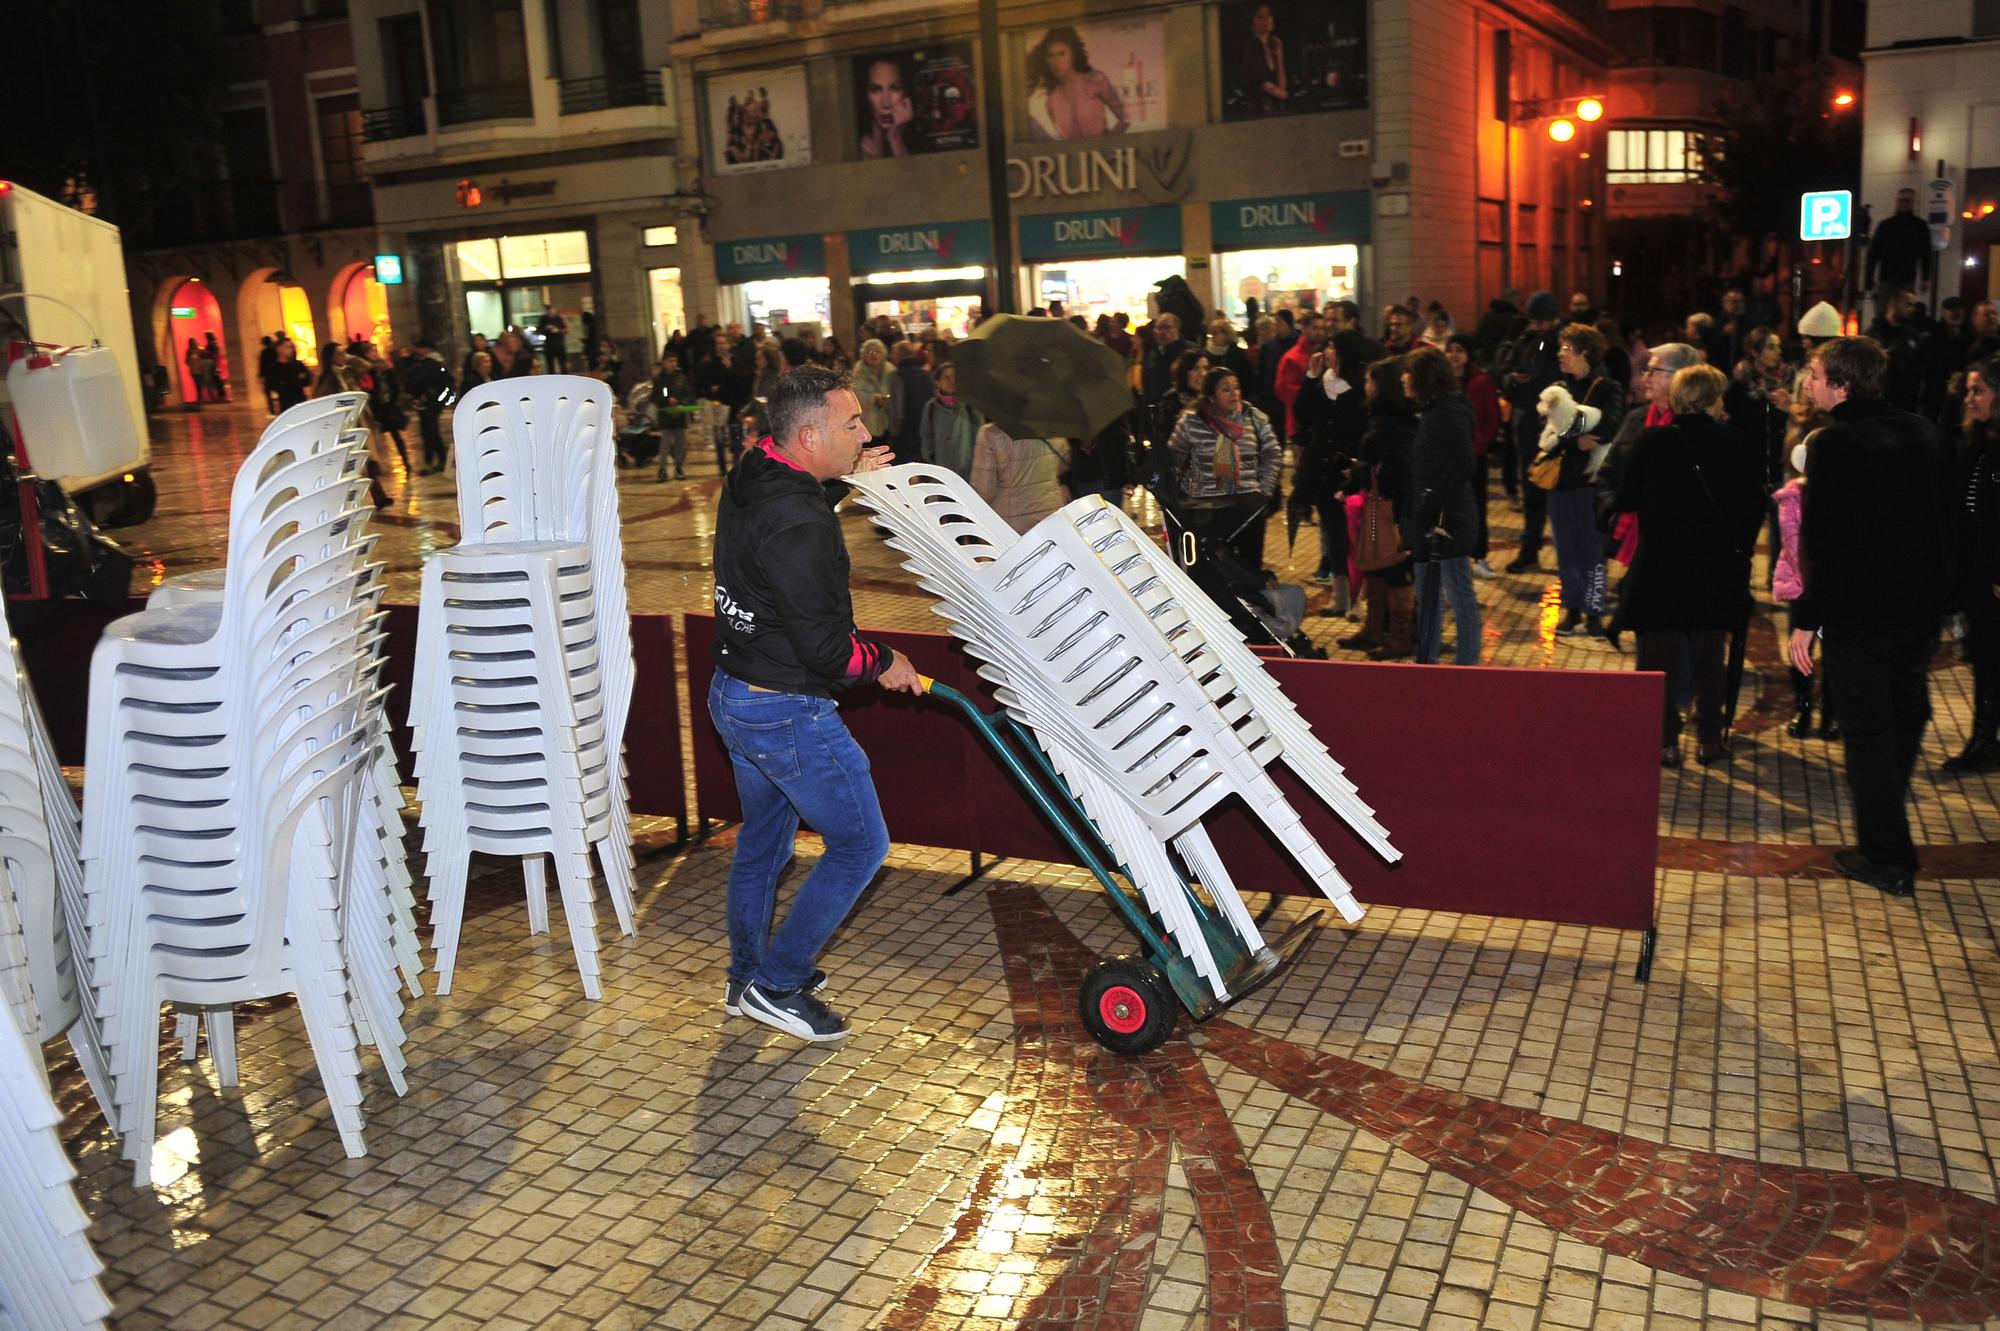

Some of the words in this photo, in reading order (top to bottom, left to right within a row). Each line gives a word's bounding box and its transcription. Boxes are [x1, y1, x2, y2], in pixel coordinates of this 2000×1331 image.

[1006, 147, 1138, 199] DRUNI
[1240, 202, 1316, 228] DRUNI
[1811, 197, 1841, 235] P
[1054, 216, 1122, 241] DRUNI
[733, 242, 787, 265] DRUNI
[878, 230, 940, 254] DRUNI
